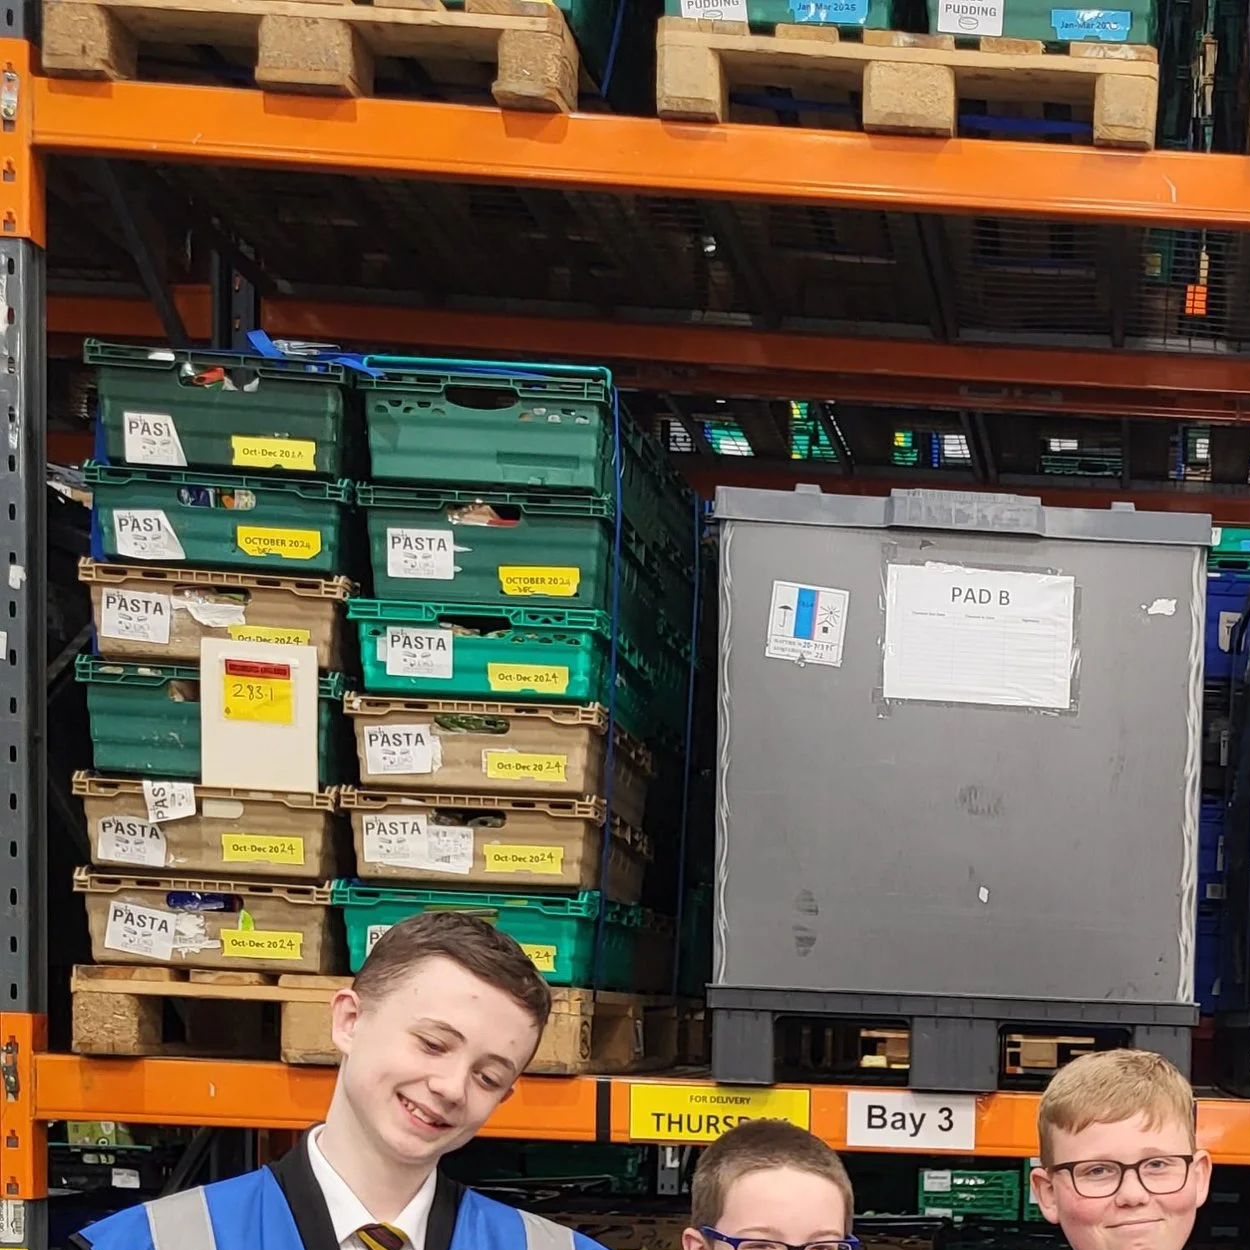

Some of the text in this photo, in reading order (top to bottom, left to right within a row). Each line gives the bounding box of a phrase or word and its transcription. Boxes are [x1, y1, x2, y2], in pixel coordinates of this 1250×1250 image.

[945, 4, 997, 17] PUDDING
[1061, 21, 1094, 30] Jan-Mar
[242, 447, 278, 458] Oct-Dec
[244, 537, 287, 547] OCTOBER
[391, 536, 448, 551] PASTA
[506, 576, 546, 585] OCTOBER
[951, 587, 1011, 606] PAD B
[106, 595, 164, 616] PASTA
[391, 635, 447, 651] PASTA
[498, 673, 559, 684] Oct-Dec 2024
[368, 733, 426, 748] PASTA
[497, 761, 532, 772] Oct-Dec
[151, 781, 169, 820] PAS
[101, 821, 161, 840] PASTA
[365, 821, 422, 836] PASTA
[231, 842, 296, 855] Oct-Dec 2024
[493, 852, 555, 864] Oct-Dec 2024
[113, 908, 169, 933] PASTA
[231, 938, 296, 951] Oct-Dec 2024
[689, 1094, 752, 1105] FOR DELIVERY
[651, 1112, 789, 1135] THURS
[867, 1104, 955, 1138] Bay 3
